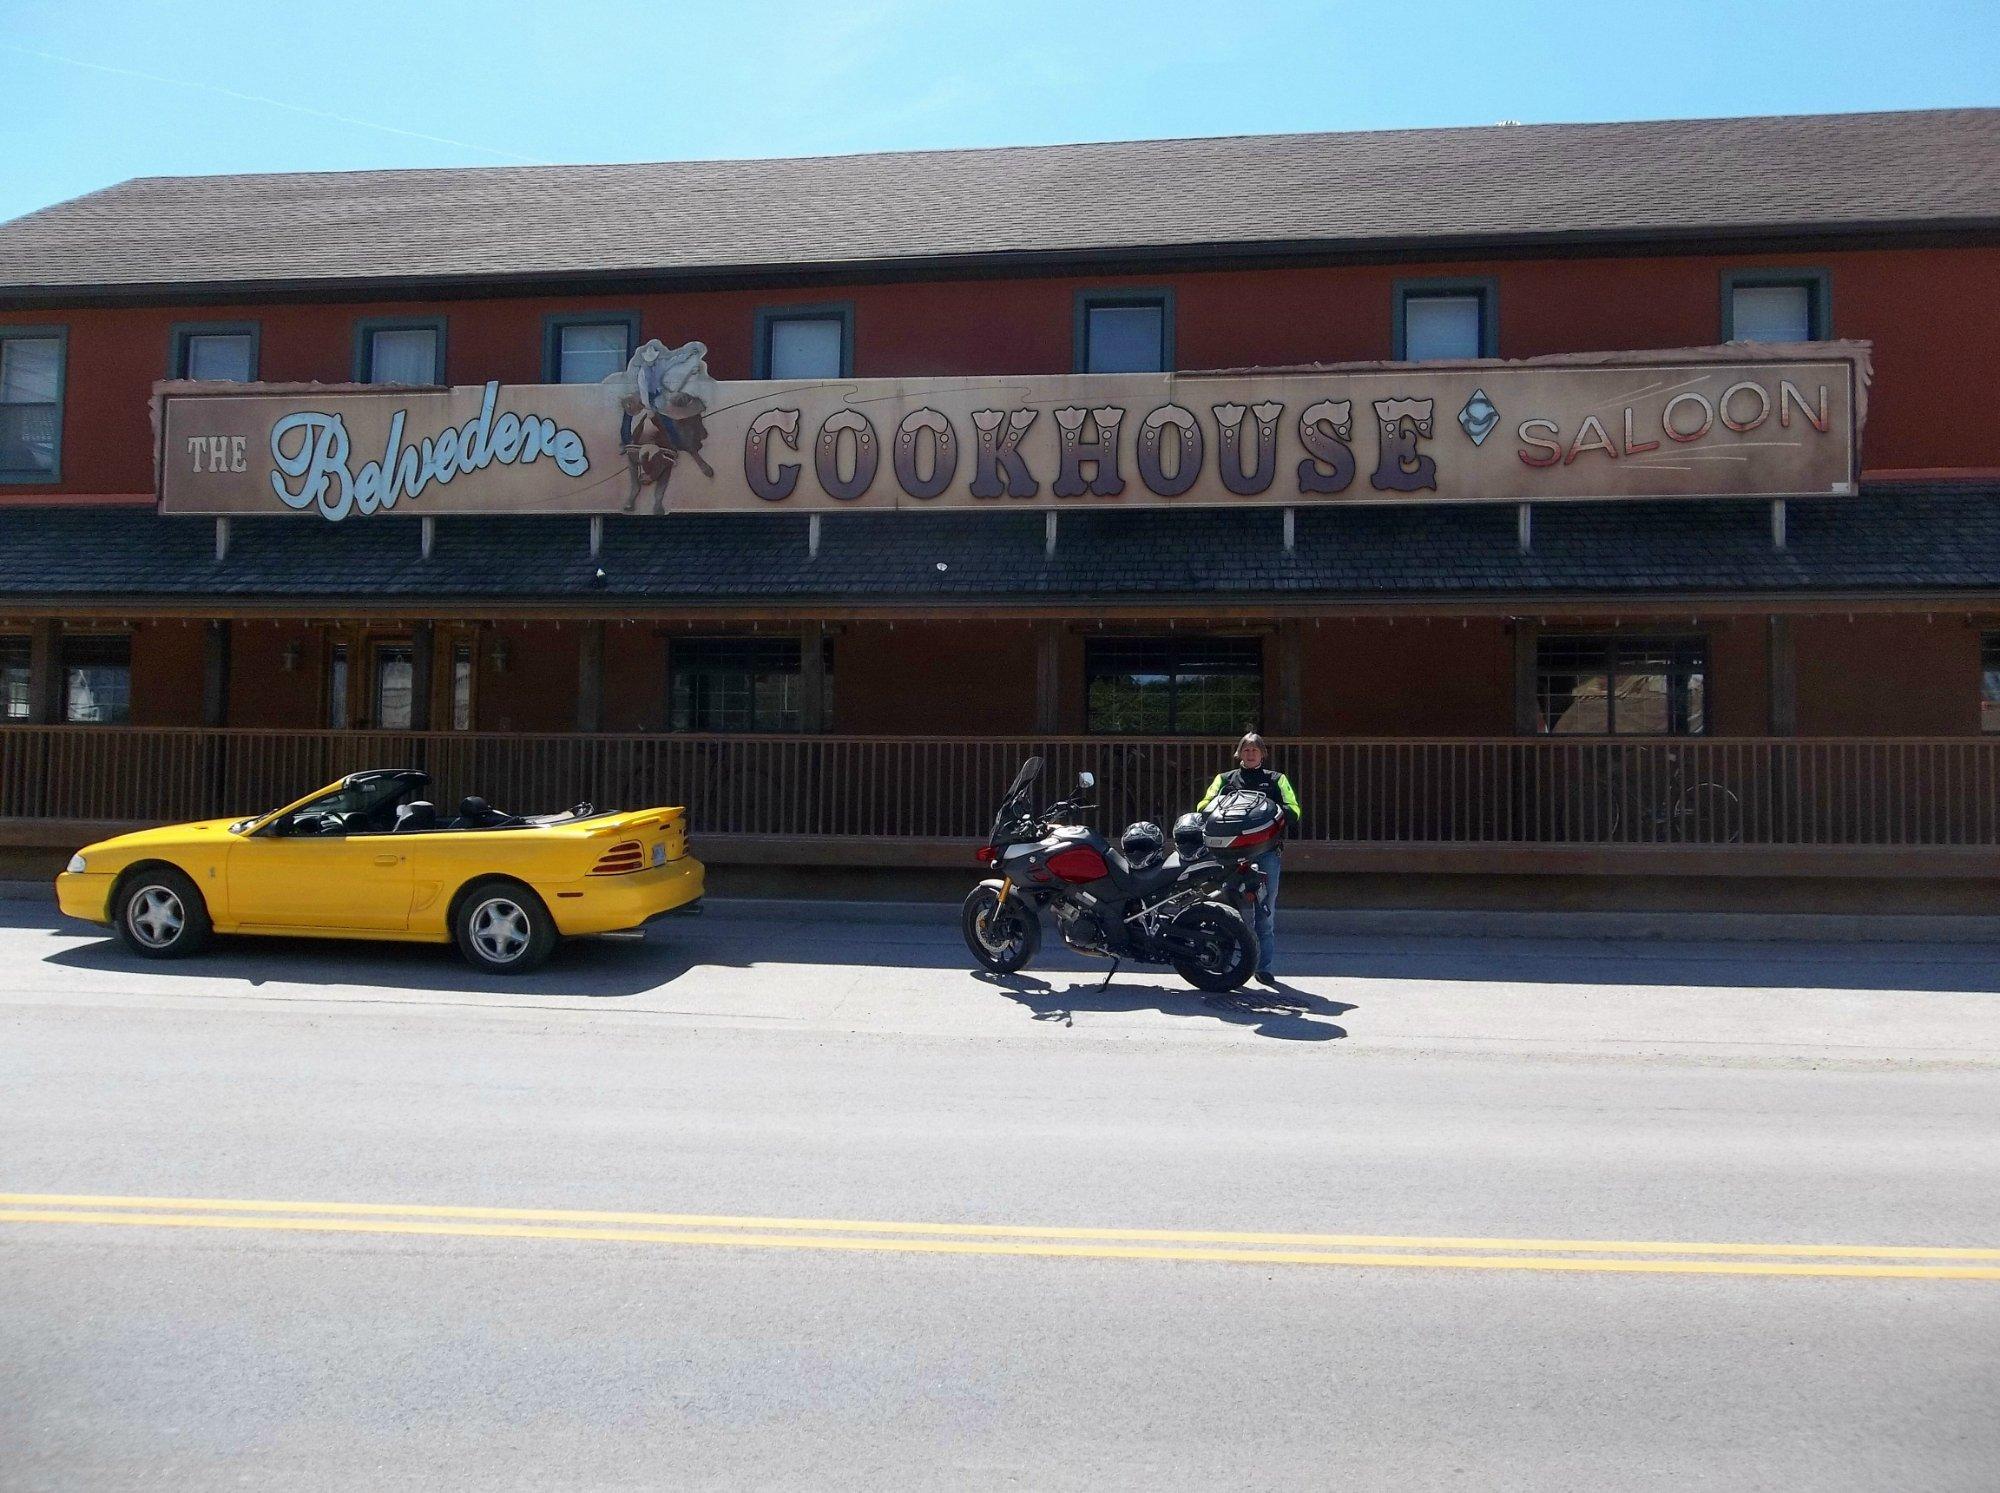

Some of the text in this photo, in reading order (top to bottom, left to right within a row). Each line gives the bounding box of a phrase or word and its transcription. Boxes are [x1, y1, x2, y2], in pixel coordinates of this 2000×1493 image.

[187, 435, 248, 473] THE
[270, 380, 590, 522] Belvedere
[744, 398, 1437, 500] COOKHOUSE
[1517, 380, 1830, 467] SALOON
